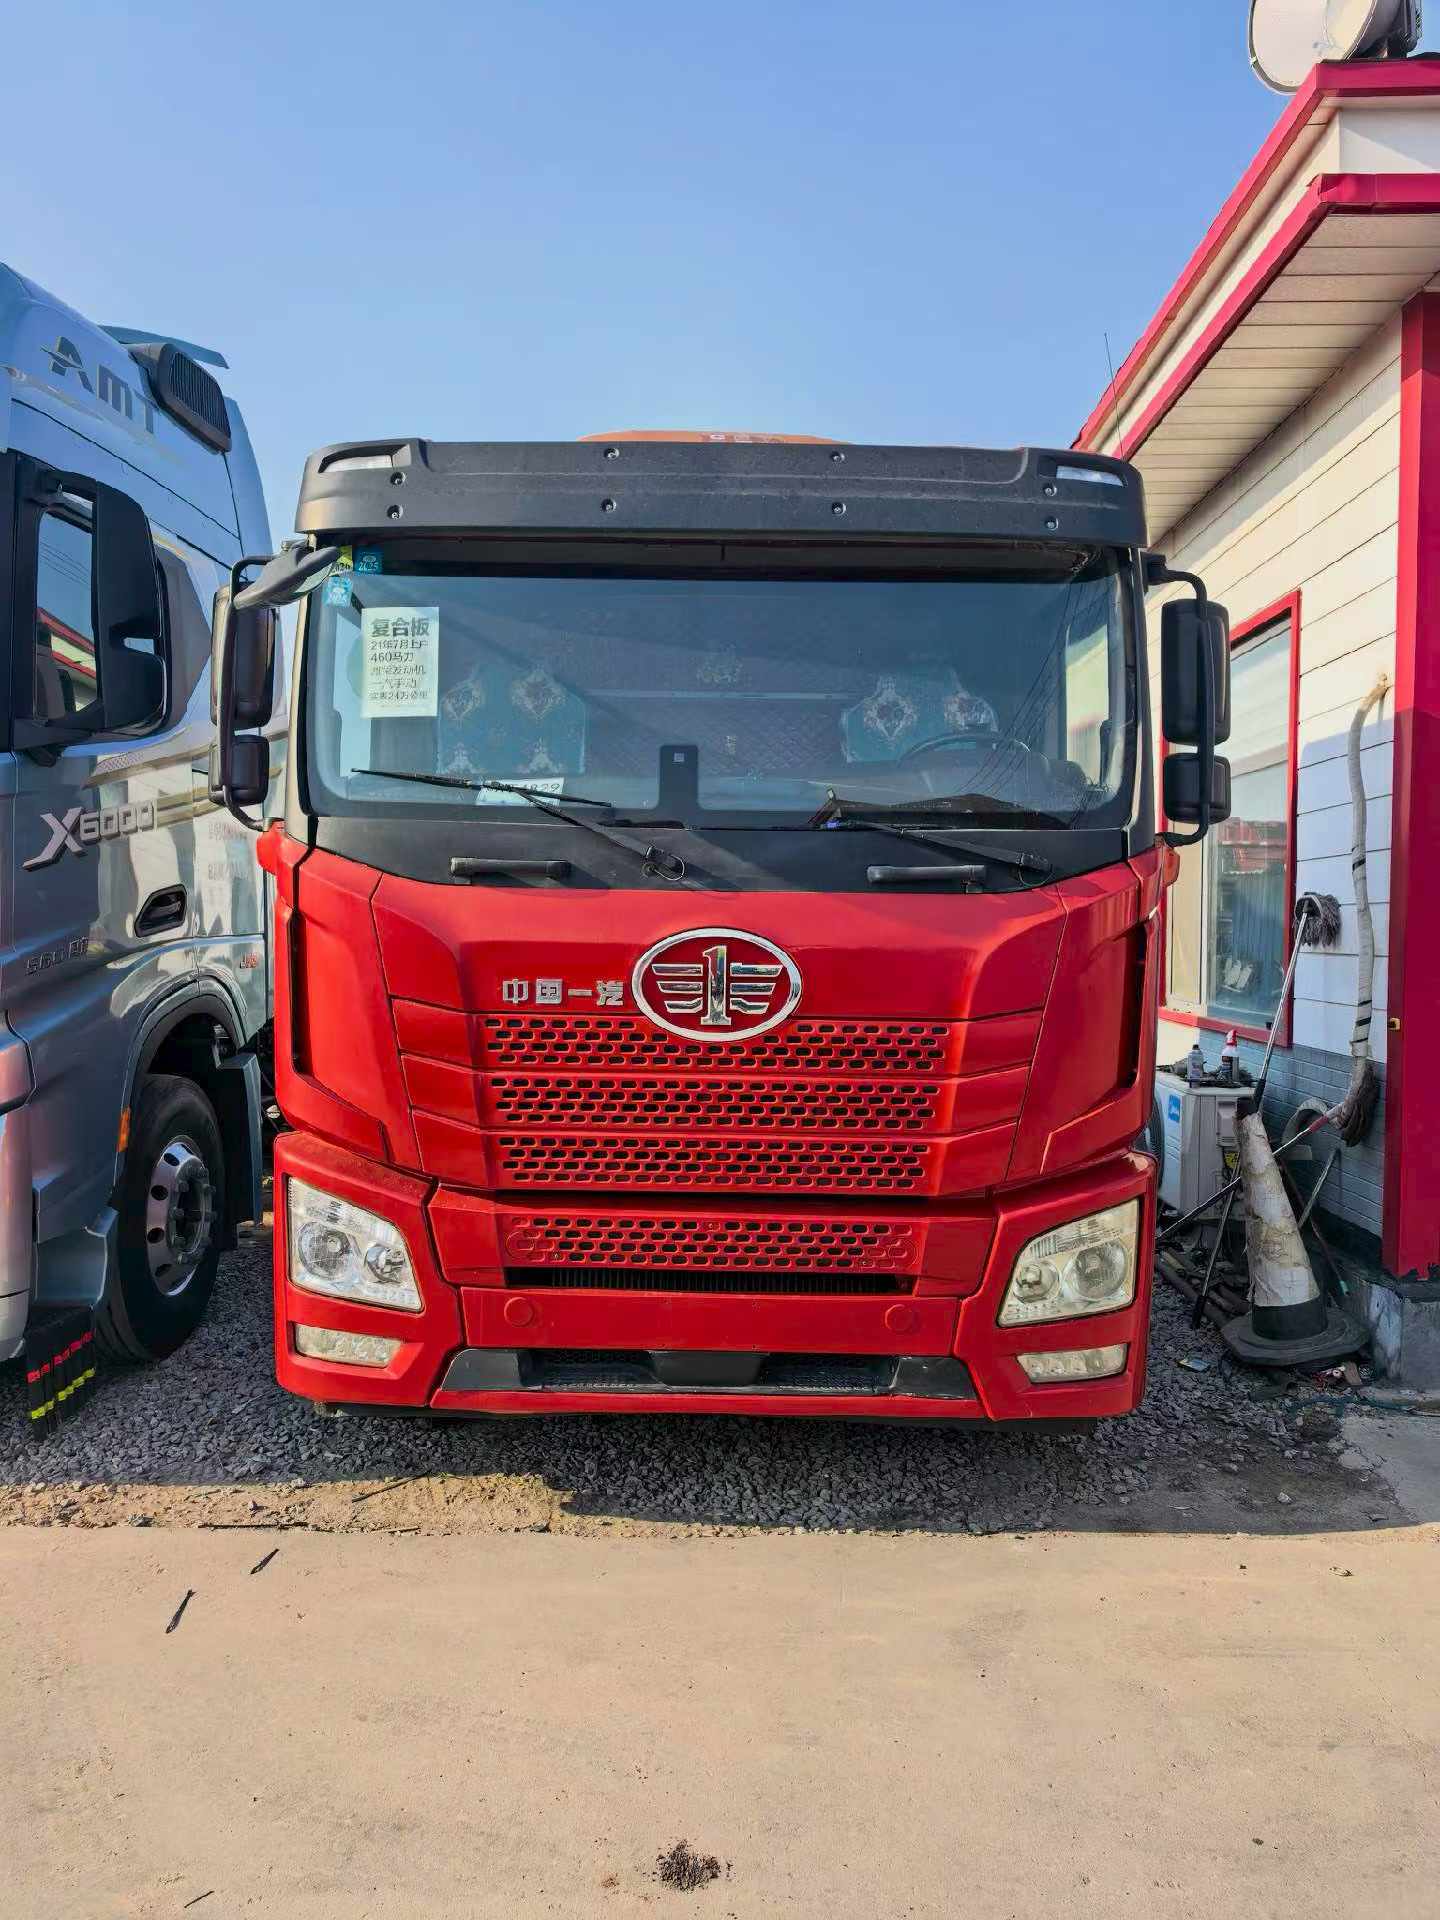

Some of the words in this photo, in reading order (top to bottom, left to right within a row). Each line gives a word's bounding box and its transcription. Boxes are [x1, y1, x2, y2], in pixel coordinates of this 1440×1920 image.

[42, 336, 159, 434] AMT
[371, 616, 430, 638] 复合板
[370, 651, 414, 662] 460马力
[22, 800, 156, 872] X6000
[502, 978, 625, 1007] 中国一汽
